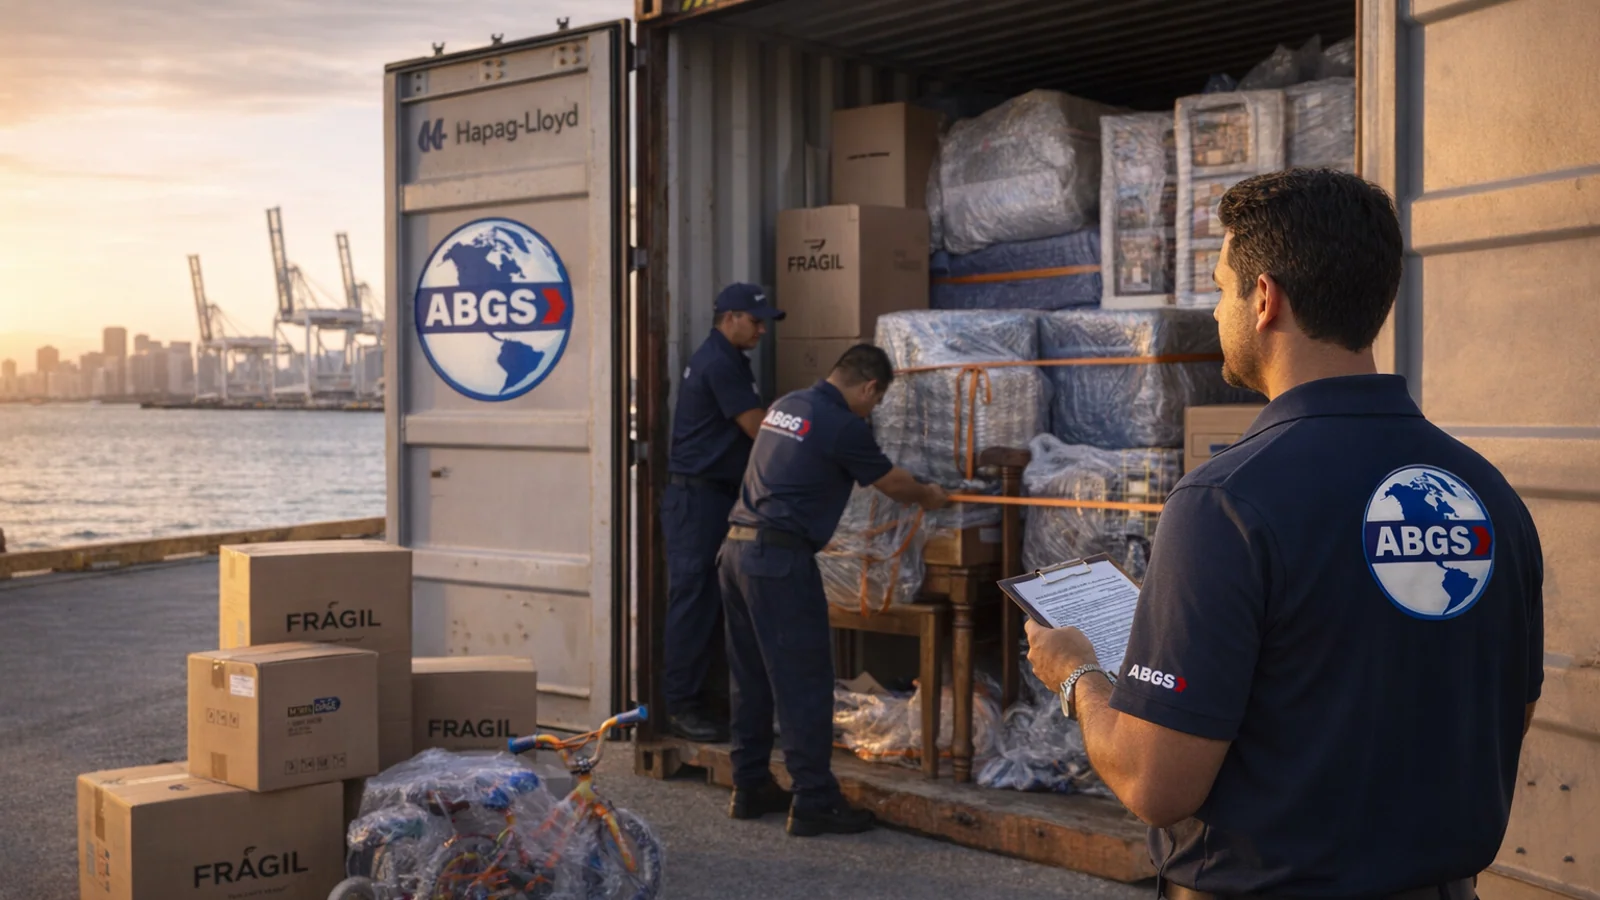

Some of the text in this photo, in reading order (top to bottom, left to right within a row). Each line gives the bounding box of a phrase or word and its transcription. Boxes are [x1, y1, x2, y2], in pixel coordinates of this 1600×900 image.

[456, 102, 579, 146] Hapag-Lloyd
[425, 288, 537, 327] ABGS
[1375, 525, 1472, 556] ABGS
[286, 601, 382, 633] FRÁGIL
[1127, 663, 1176, 690] ABGS
[428, 718, 518, 738] FRAGIL
[193, 846, 309, 889] FRÁGIL
